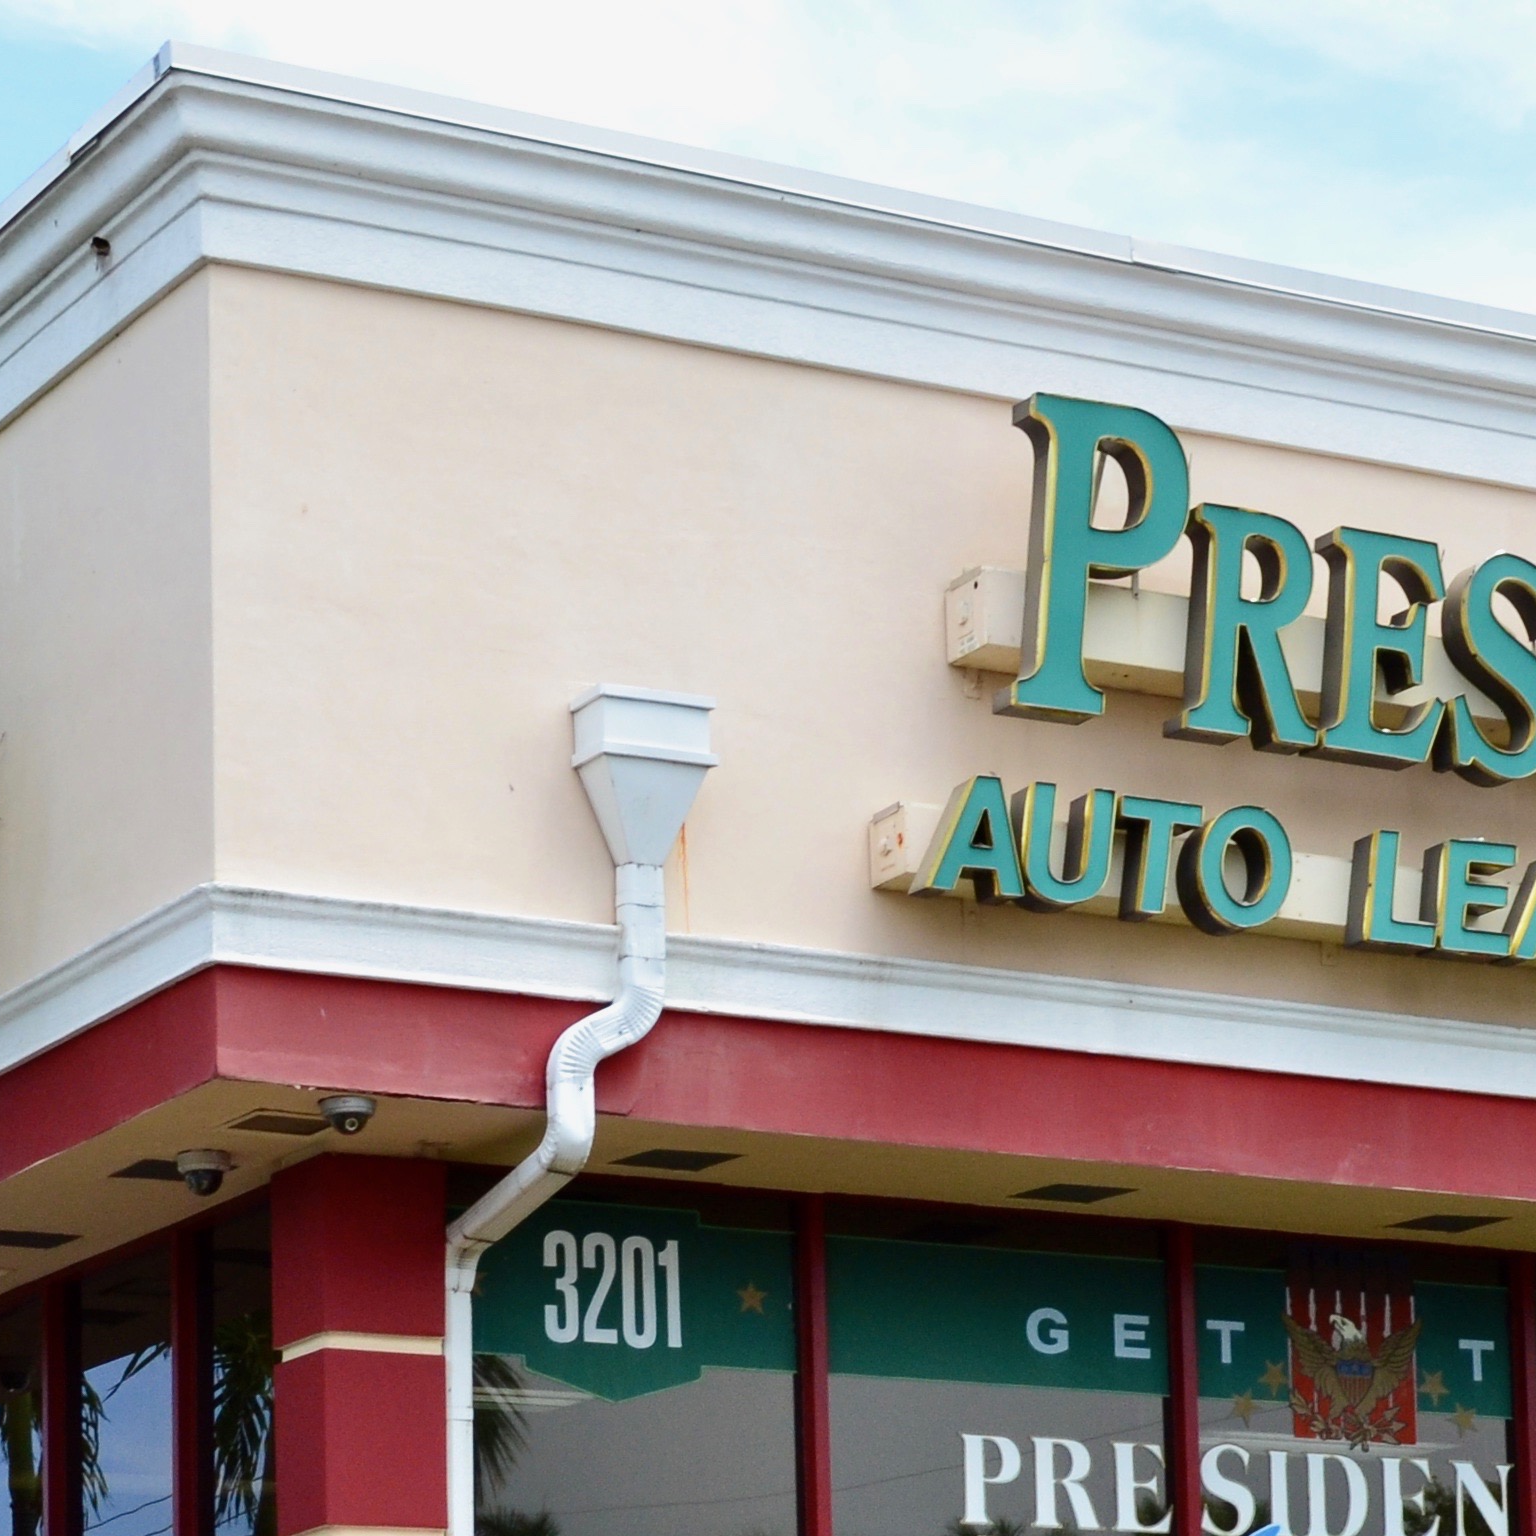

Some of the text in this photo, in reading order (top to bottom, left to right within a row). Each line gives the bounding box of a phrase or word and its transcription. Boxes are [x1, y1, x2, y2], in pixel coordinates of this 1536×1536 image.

[916, 775, 1294, 935] AUTO
[542, 1229, 683, 1349] 3201
[1025, 1307, 1245, 1364] GET
